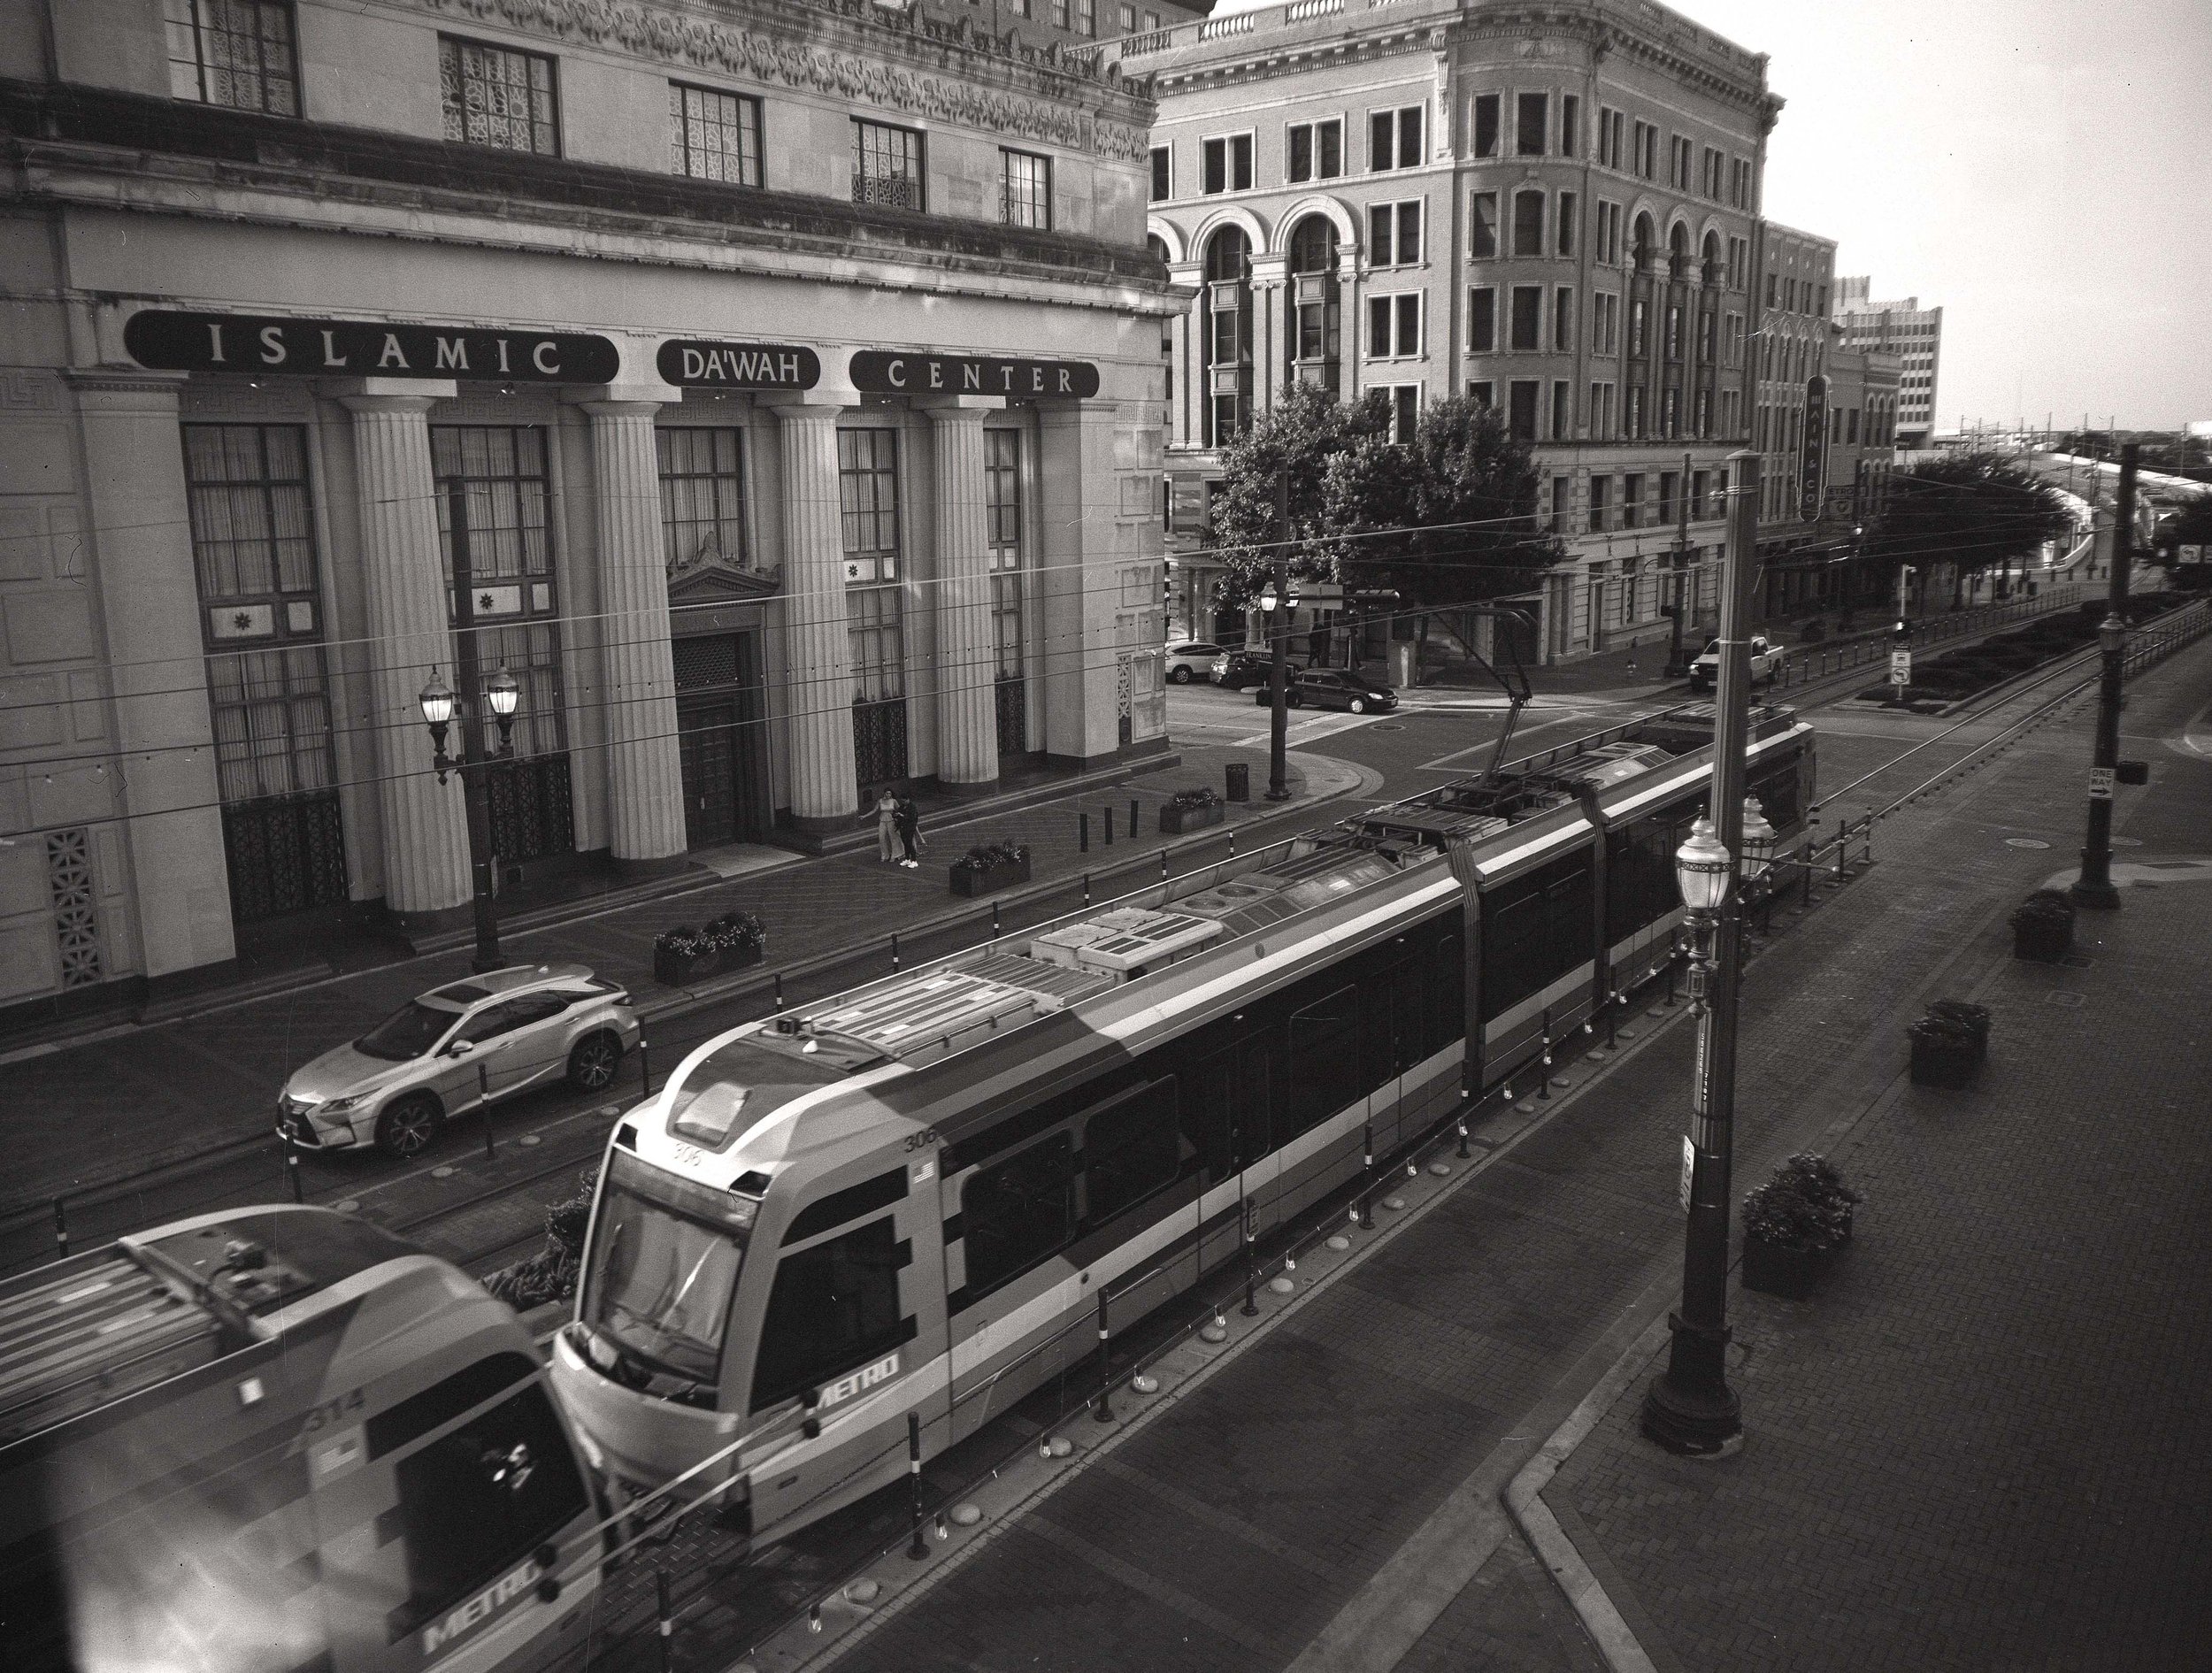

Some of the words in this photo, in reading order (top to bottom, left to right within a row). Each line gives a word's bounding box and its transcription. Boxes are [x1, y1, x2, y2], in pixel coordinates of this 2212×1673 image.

[207, 324, 561, 375] ISLAMIC
[682, 348, 799, 383] DA'WAH
[887, 360, 1073, 393] CENTER
[1805, 480, 1816, 503] CO
[2093, 770, 2112, 779] ONE
[903, 1124, 937, 1153] 306
